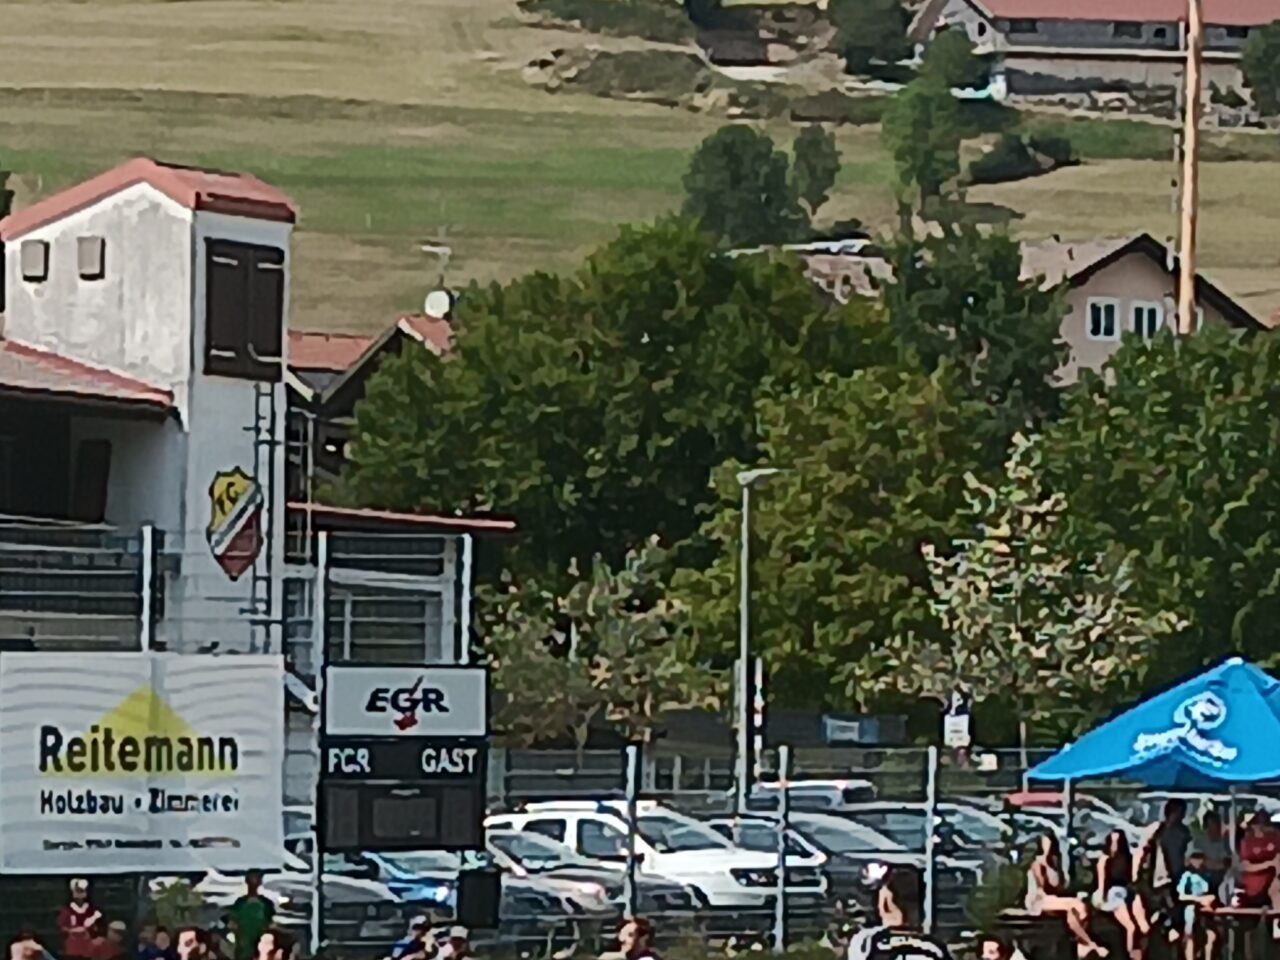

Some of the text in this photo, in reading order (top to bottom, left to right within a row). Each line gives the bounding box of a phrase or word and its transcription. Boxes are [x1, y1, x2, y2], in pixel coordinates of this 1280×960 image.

[365, 687, 450, 713] EGR
[39, 724, 239, 773] Reitemann
[328, 747, 371, 773] FCR
[421, 747, 478, 773] GAST
[40, 789, 124, 814] Holzbau
